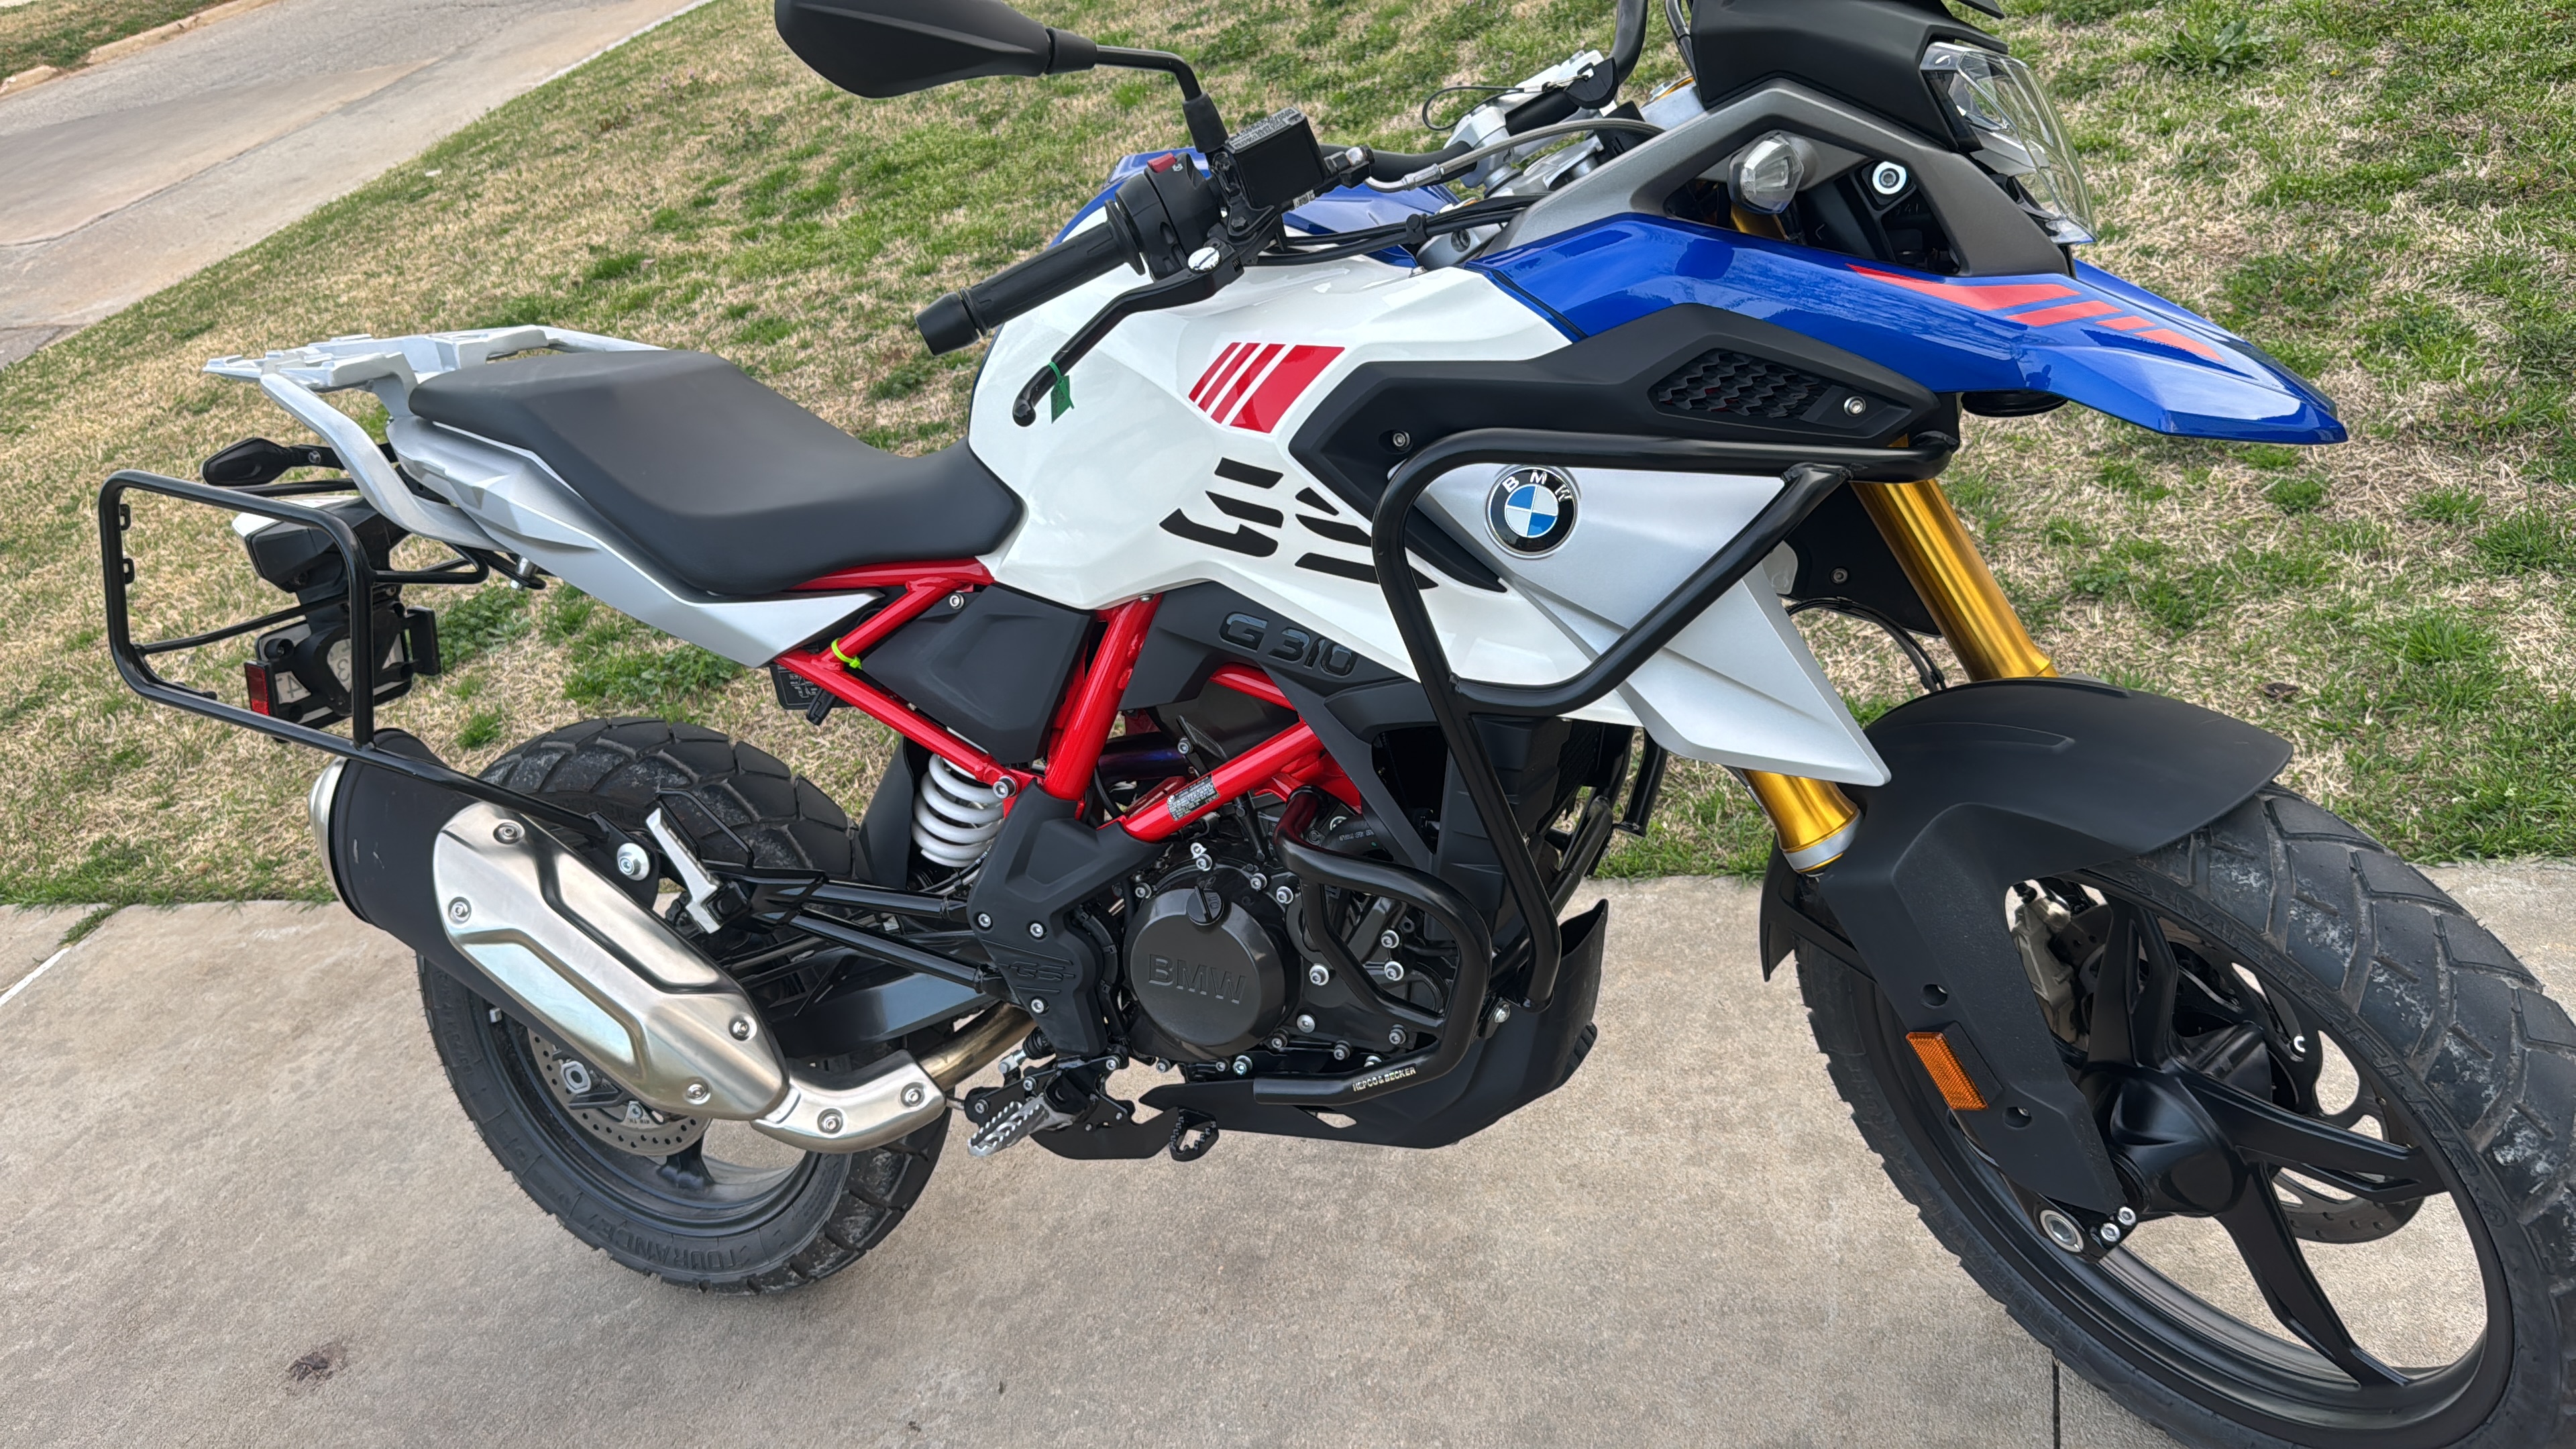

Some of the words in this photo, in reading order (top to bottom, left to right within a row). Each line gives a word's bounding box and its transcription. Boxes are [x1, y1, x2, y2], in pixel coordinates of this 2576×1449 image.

[1502, 470, 1572, 503] BMW
[1219, 611, 1269, 653] G
[1268, 627, 1358, 678] 310
[1149, 953, 1247, 1004] BMW
